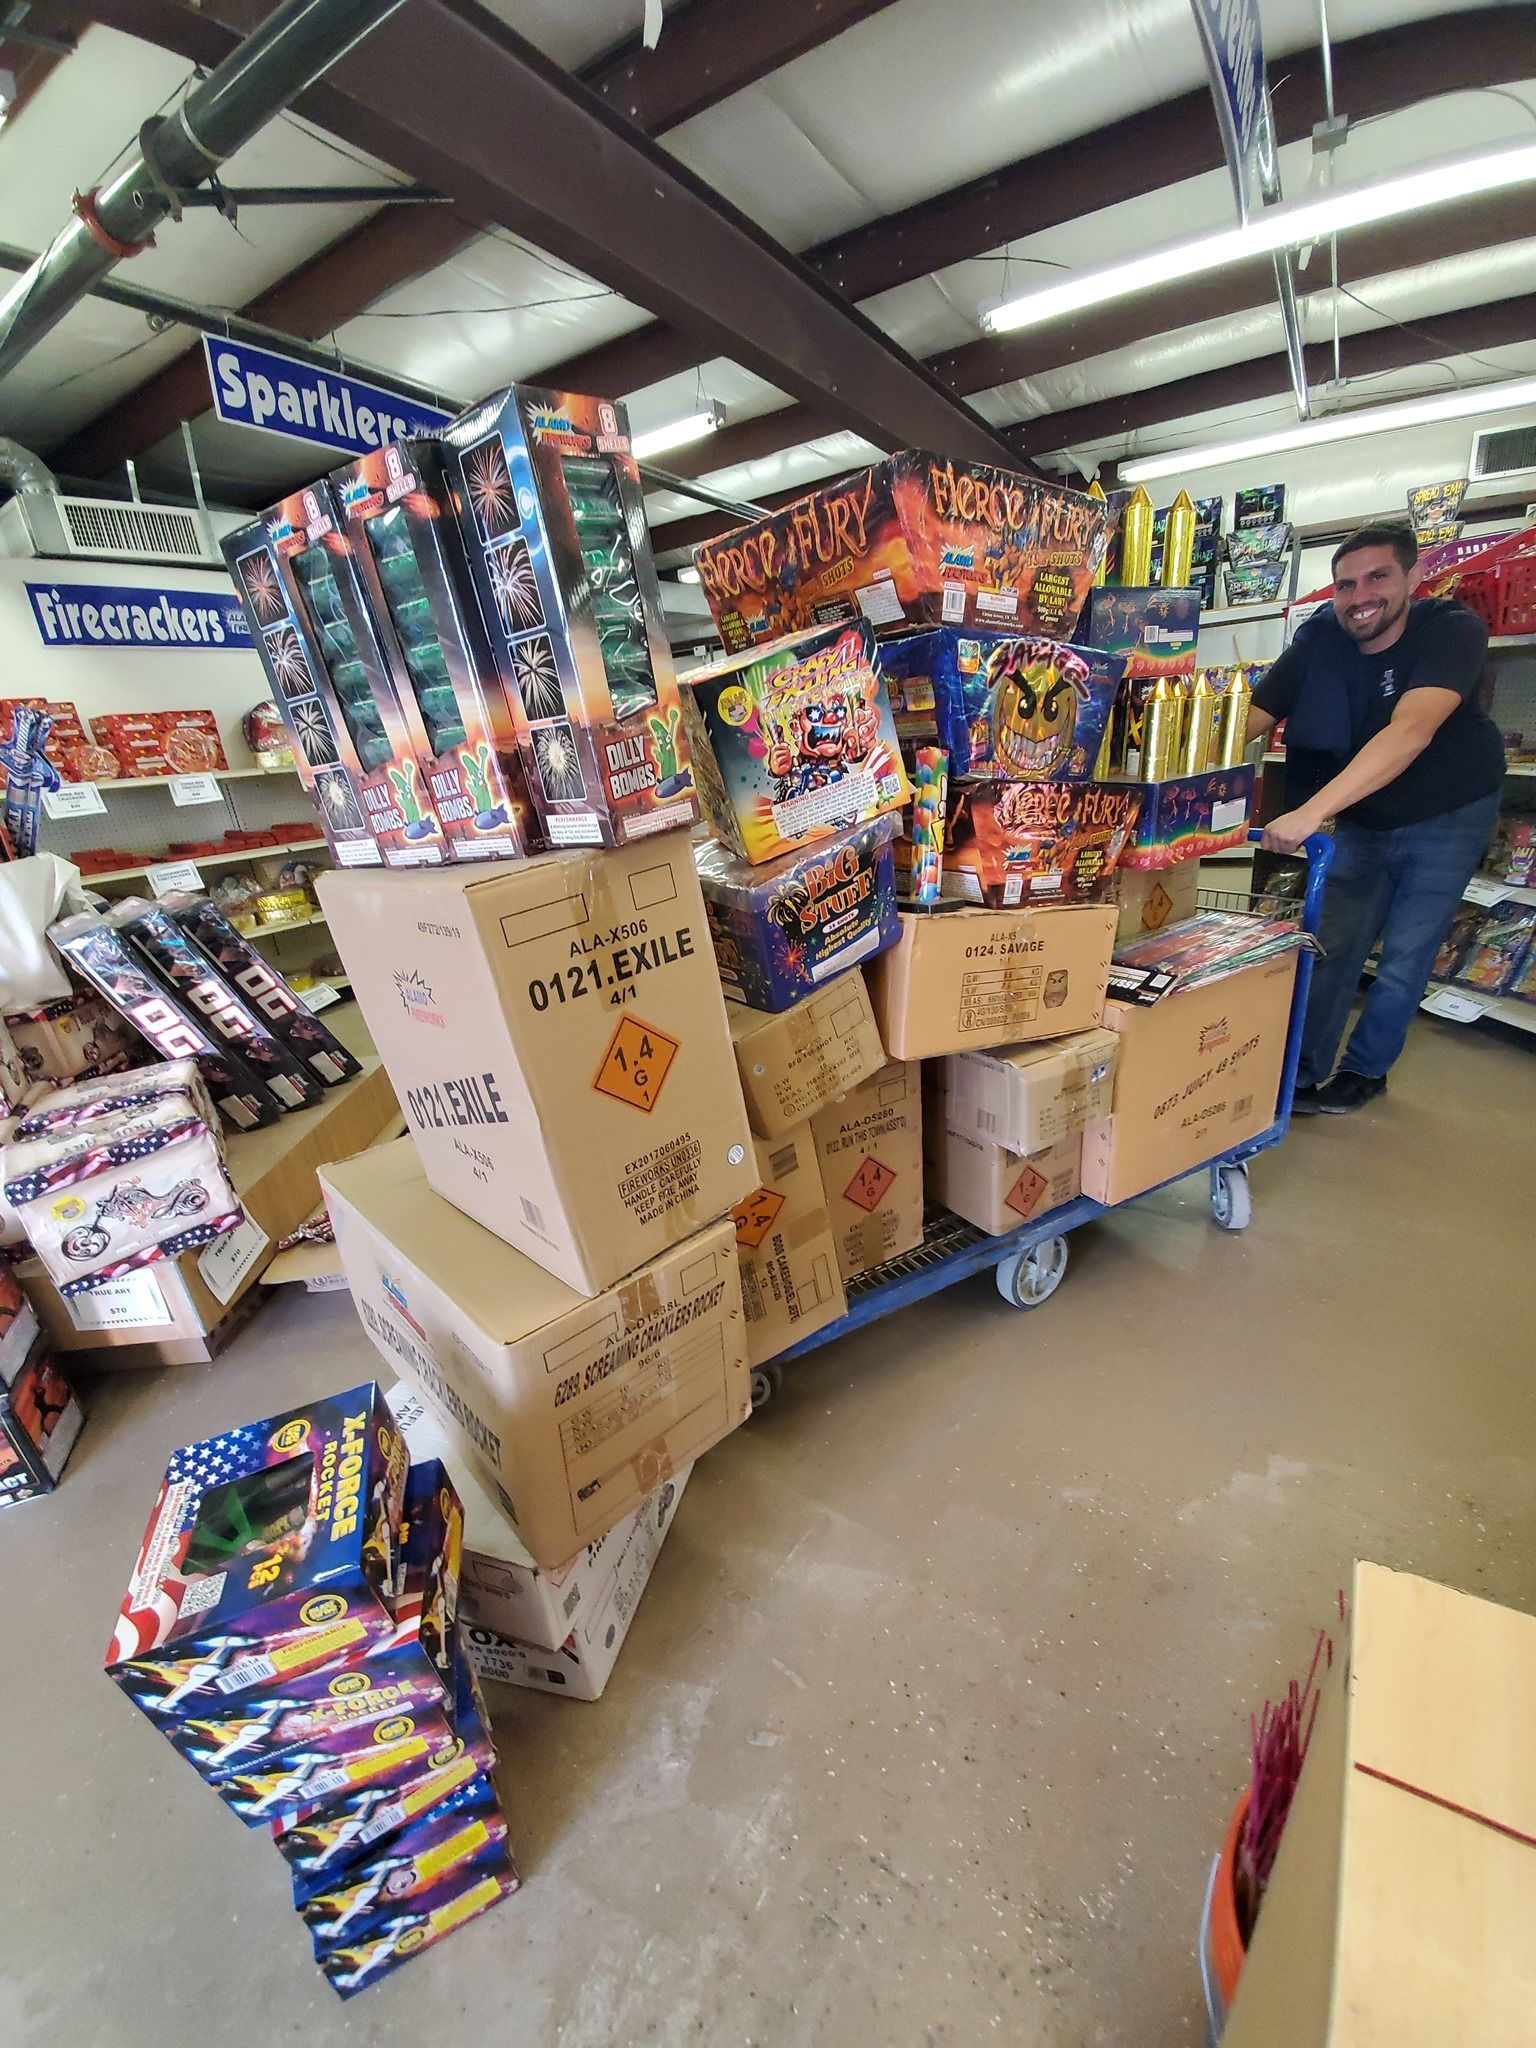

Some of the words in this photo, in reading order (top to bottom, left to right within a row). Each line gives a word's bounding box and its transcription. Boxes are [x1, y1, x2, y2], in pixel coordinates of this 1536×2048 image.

[217, 353, 407, 446] Sparklers
[598, 404, 618, 436] 8
[597, 435, 630, 453] SHELLS
[385, 447, 403, 480] 8
[386, 474, 416, 502] SHELLS
[303, 491, 321, 521] 8
[793, 467, 874, 569] FURY
[307, 515, 332, 541] SHELLS
[821, 556, 854, 587] SHOTS
[943, 552, 974, 568] ALAMO
[1034, 583, 1073, 597] ALLOWABLE
[1039, 573, 1070, 585] LARGEST
[35, 588, 225, 644] Firecrackers
[606, 734, 647, 771] DILLY
[362, 783, 391, 812] DILLY
[431, 768, 461, 799] DILLY
[609, 764, 655, 801] BOMBS
[439, 797, 474, 824] BOMBS
[780, 795, 810, 810] WARNING
[1082, 788, 1129, 828] FURY
[371, 810, 403, 835] BOMBS
[800, 868, 874, 935] STUFF
[569, 918, 648, 958] ALA-X506
[815, 937, 846, 961] Highest
[825, 920, 859, 946] Absolute
[965, 944, 997, 958] 0124.
[1000, 940, 1045, 955] SAVAGE
[528, 927, 695, 1012] 0121.EXILE
[235, 965, 297, 1021] OG
[610, 986, 638, 1005] 4/1
[187, 979, 255, 1040] OG
[132, 998, 205, 1059] OG
[1229, 1034, 1260, 1066] SHOTS
[634, 1068, 648, 1087] G
[407, 1072, 509, 1129] 0121.EXILE
[839, 1107, 895, 1135] ALA-D5280
[453, 1137, 495, 1171] ALA-X506
[624, 1131, 691, 1176] EX2017060495
[472, 1166, 488, 1184] 4/1
[621, 1160, 671, 1196] FIREWORKS
[624, 1182, 657, 1209] HANDLE
[659, 1156, 702, 1189] CAREFULLY
[633, 1196, 655, 1216] KEEP
[658, 1184, 676, 1202] FIRE
[678, 1170, 698, 1189] AWAY
[640, 1205, 665, 1226] MADE
[665, 1199, 674, 1210] IN
[674, 1183, 700, 1205] CHINA
[214, 1240, 228, 1258] TRUE
[89, 1287, 113, 1297] TRUE
[114, 1286, 132, 1296] ART
[110, 1306, 127, 1316] $70
[583, 1334, 640, 1391] SCREAMING
[640, 1302, 693, 1354] CRACKLERS
[692, 1280, 726, 1319] ROCKET
[316, 1440, 338, 1521] ROCKET
[330, 1411, 367, 1542] X-FORCE
[308, 1680, 418, 1723] X-FORCE
